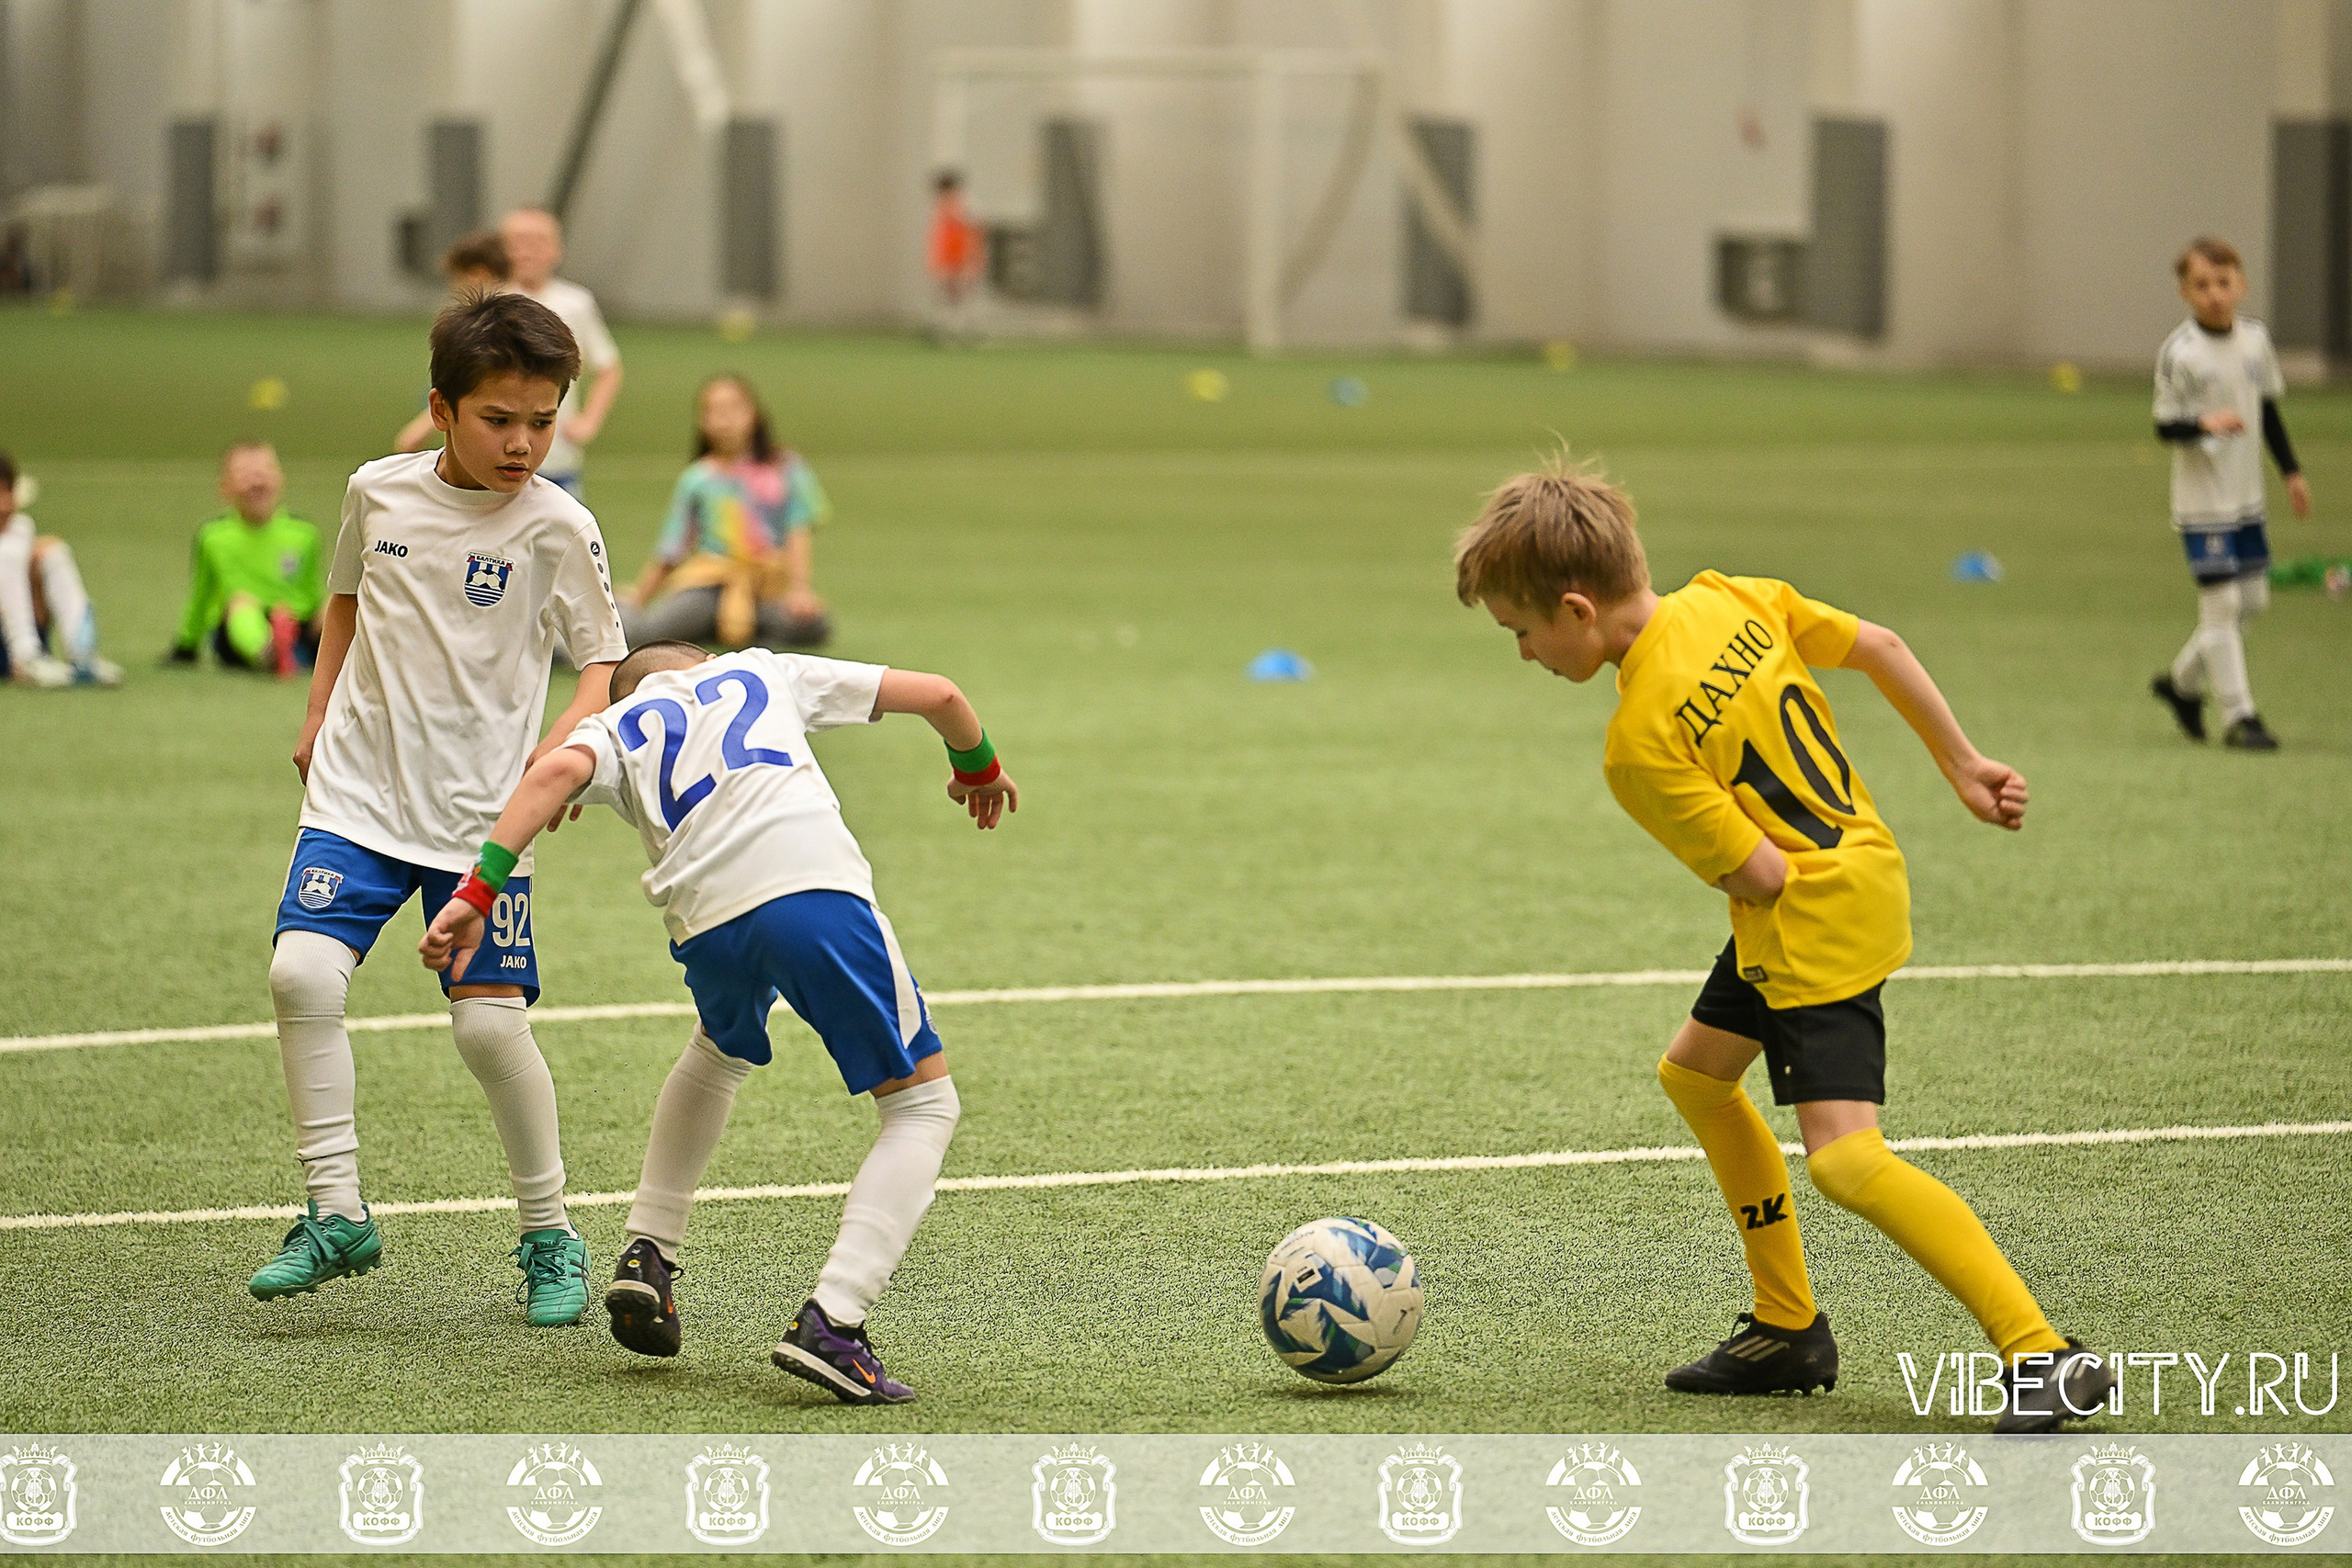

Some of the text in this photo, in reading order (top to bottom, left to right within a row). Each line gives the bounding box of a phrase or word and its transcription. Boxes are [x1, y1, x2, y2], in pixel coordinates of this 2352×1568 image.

[374, 539, 409, 558] JAKO
[1675, 619, 1773, 749] ДАХНО
[617, 670, 794, 833] 22
[1731, 683, 1857, 851] 10
[492, 893, 531, 947] 92
[500, 954, 527, 969] JAKO
